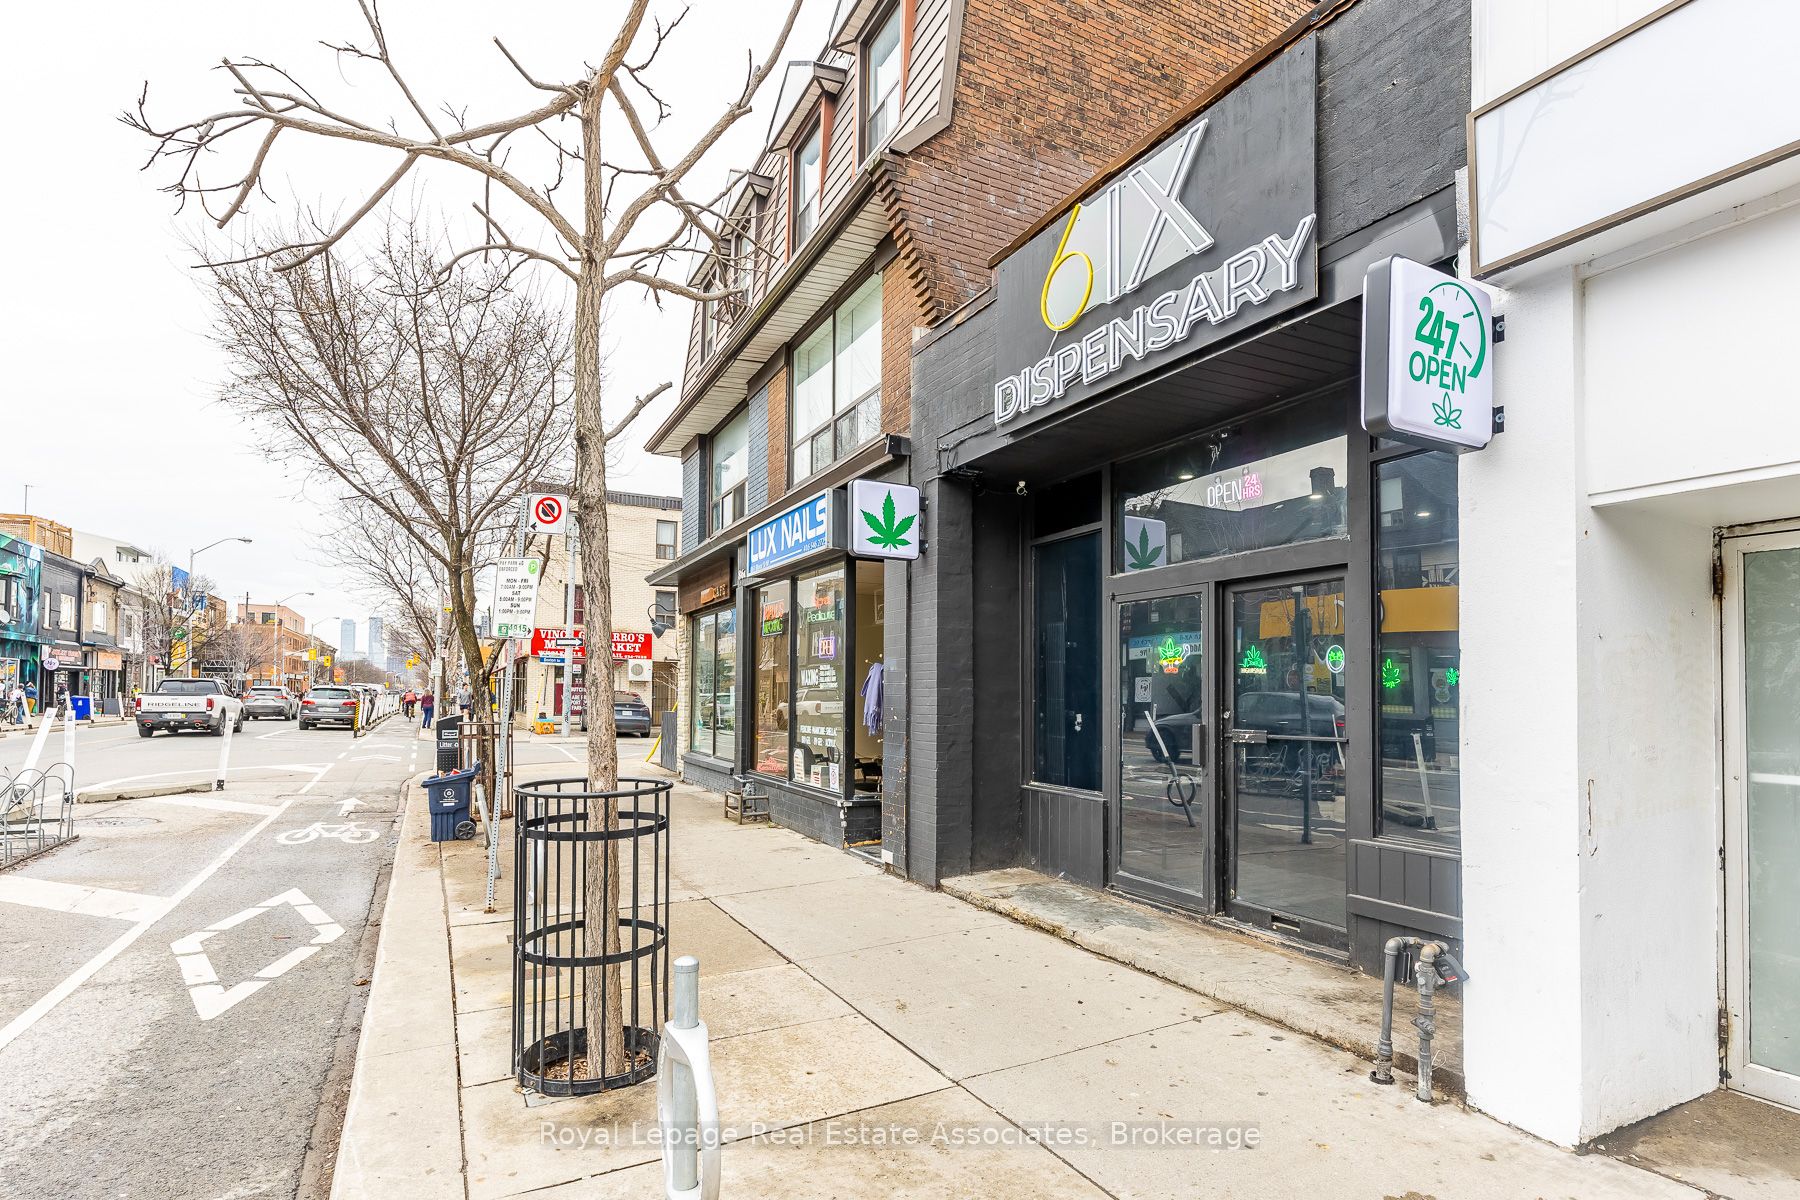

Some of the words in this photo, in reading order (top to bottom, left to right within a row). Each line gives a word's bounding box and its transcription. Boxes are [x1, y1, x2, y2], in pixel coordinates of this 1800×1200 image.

[1040, 118, 1214, 331] 6IX
[994, 213, 1317, 426] DISPENSARY
[1408, 350, 1467, 394] OPEN
[1207, 479, 1242, 507] OPEN
[1242, 484, 1261, 500] HRS
[1244, 473, 1258, 487] 24
[751, 523, 777, 563] LUX
[781, 497, 826, 551] NAILS
